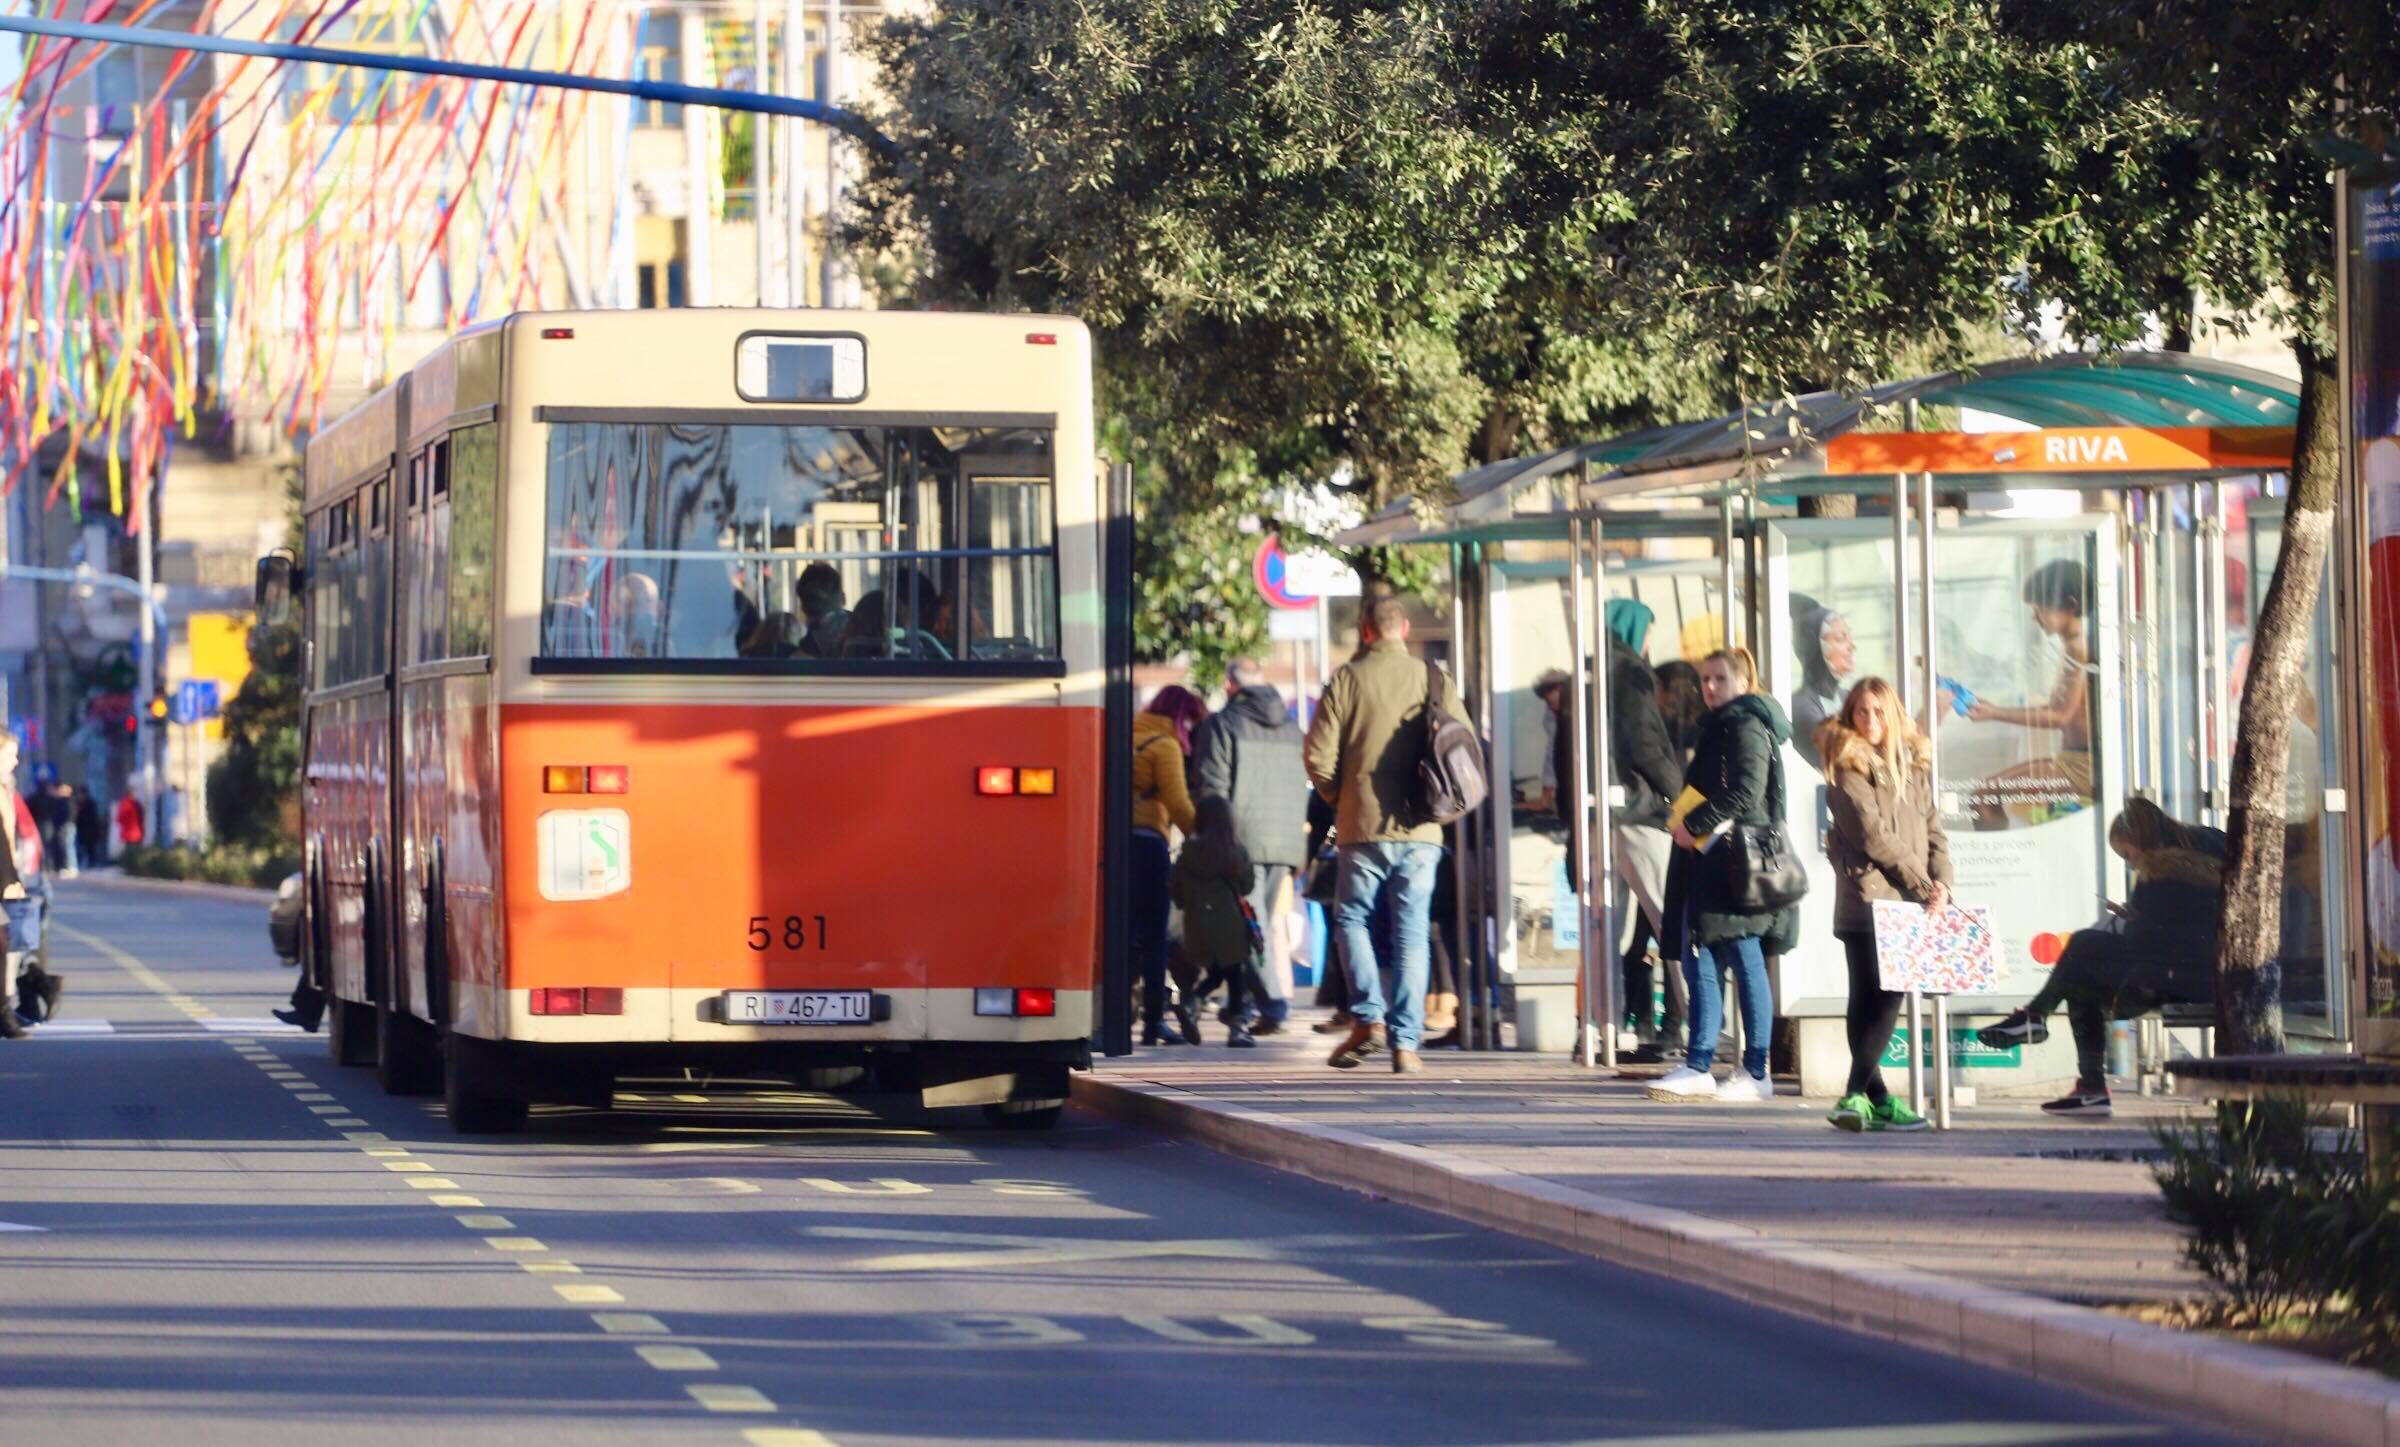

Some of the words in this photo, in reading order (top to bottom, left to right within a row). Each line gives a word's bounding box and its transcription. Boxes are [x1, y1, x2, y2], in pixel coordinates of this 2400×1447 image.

[2045, 435, 2129, 464] RIVA
[748, 915, 827, 951] 581
[745, 996, 768, 1017] RI
[788, 996, 866, 1018] 467-TU
[922, 1312, 1557, 1348] BUS
